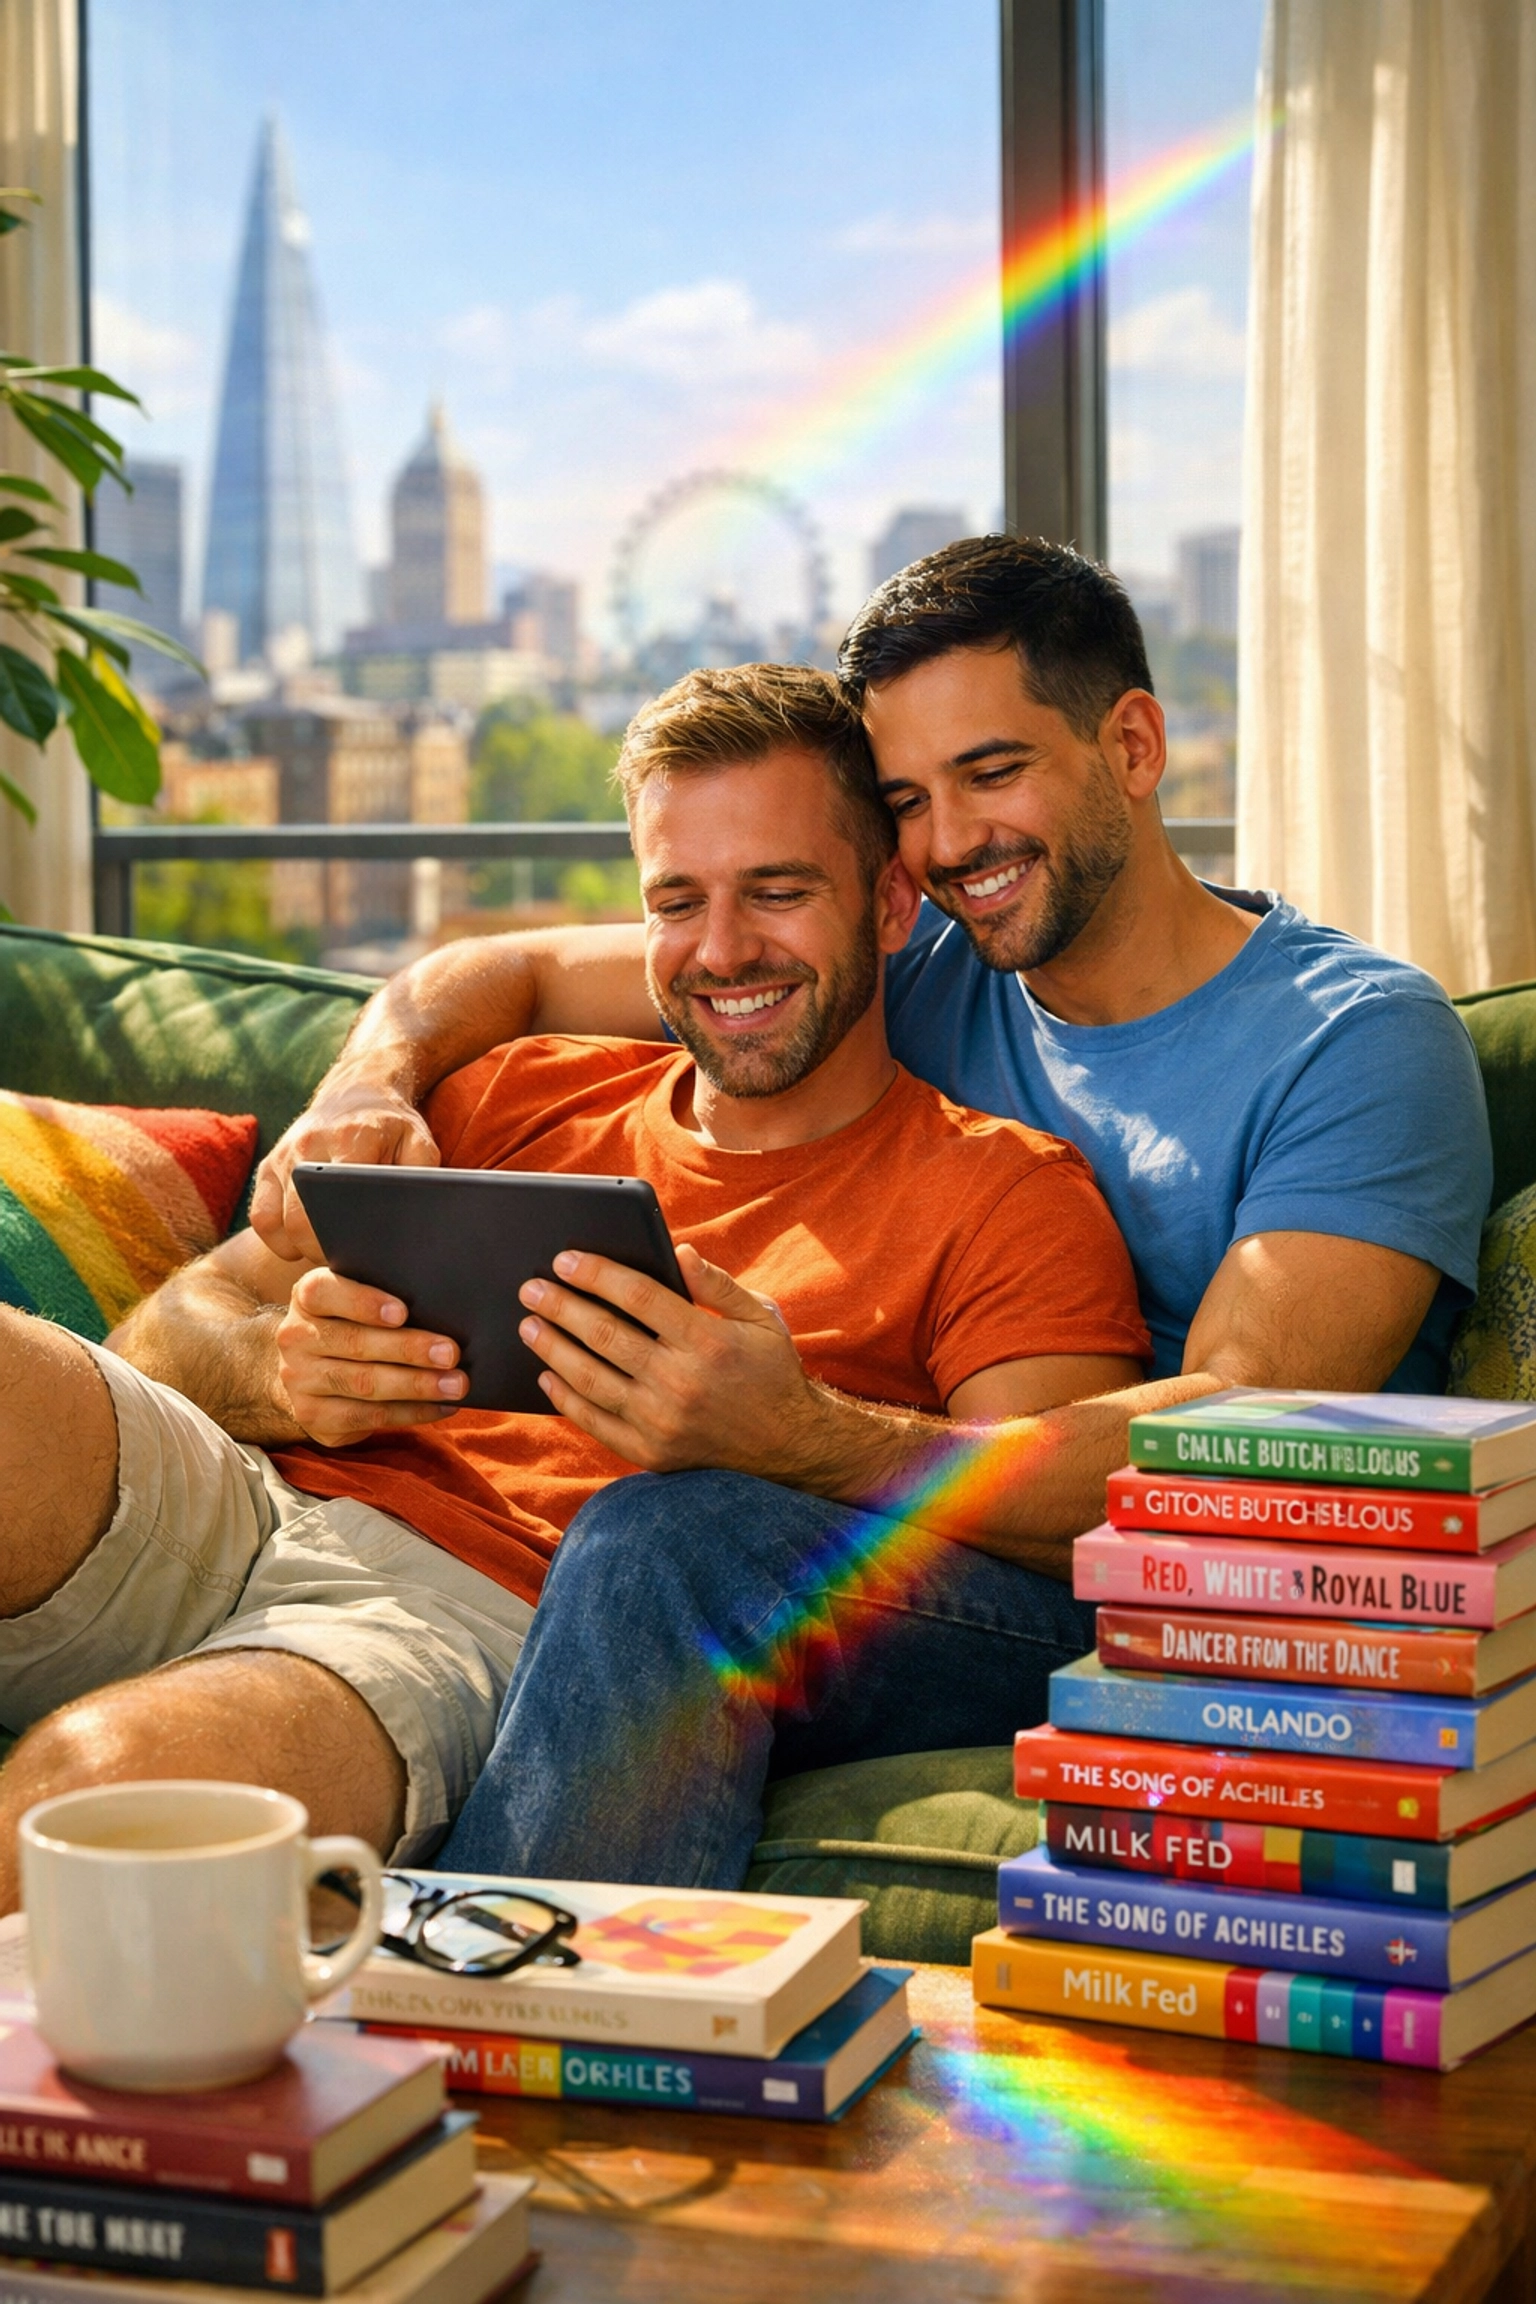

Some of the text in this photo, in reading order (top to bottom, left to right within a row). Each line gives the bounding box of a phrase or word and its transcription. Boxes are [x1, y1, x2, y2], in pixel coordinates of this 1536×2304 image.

[1145, 1489, 1233, 1520] GITONE
[1142, 1555, 1193, 1597] RED,
[1203, 1560, 1282, 1601] WHITE
[1312, 1565, 1392, 1609] ROYAL
[1401, 1574, 1466, 1615] BLUE
[1162, 1623, 1400, 1680] DANCER FROM THE DANCE
[1202, 1703, 1352, 1741] ORLANDO
[1059, 1763, 1103, 1787] THE
[1109, 1768, 1176, 1796] SONG
[1182, 1775, 1215, 1798] OF
[1065, 1824, 1233, 1870] MILK FED
[1043, 1892, 1346, 1957] THE SONG OF ACHIELES
[1063, 1968, 1198, 2016] Milk Fed
